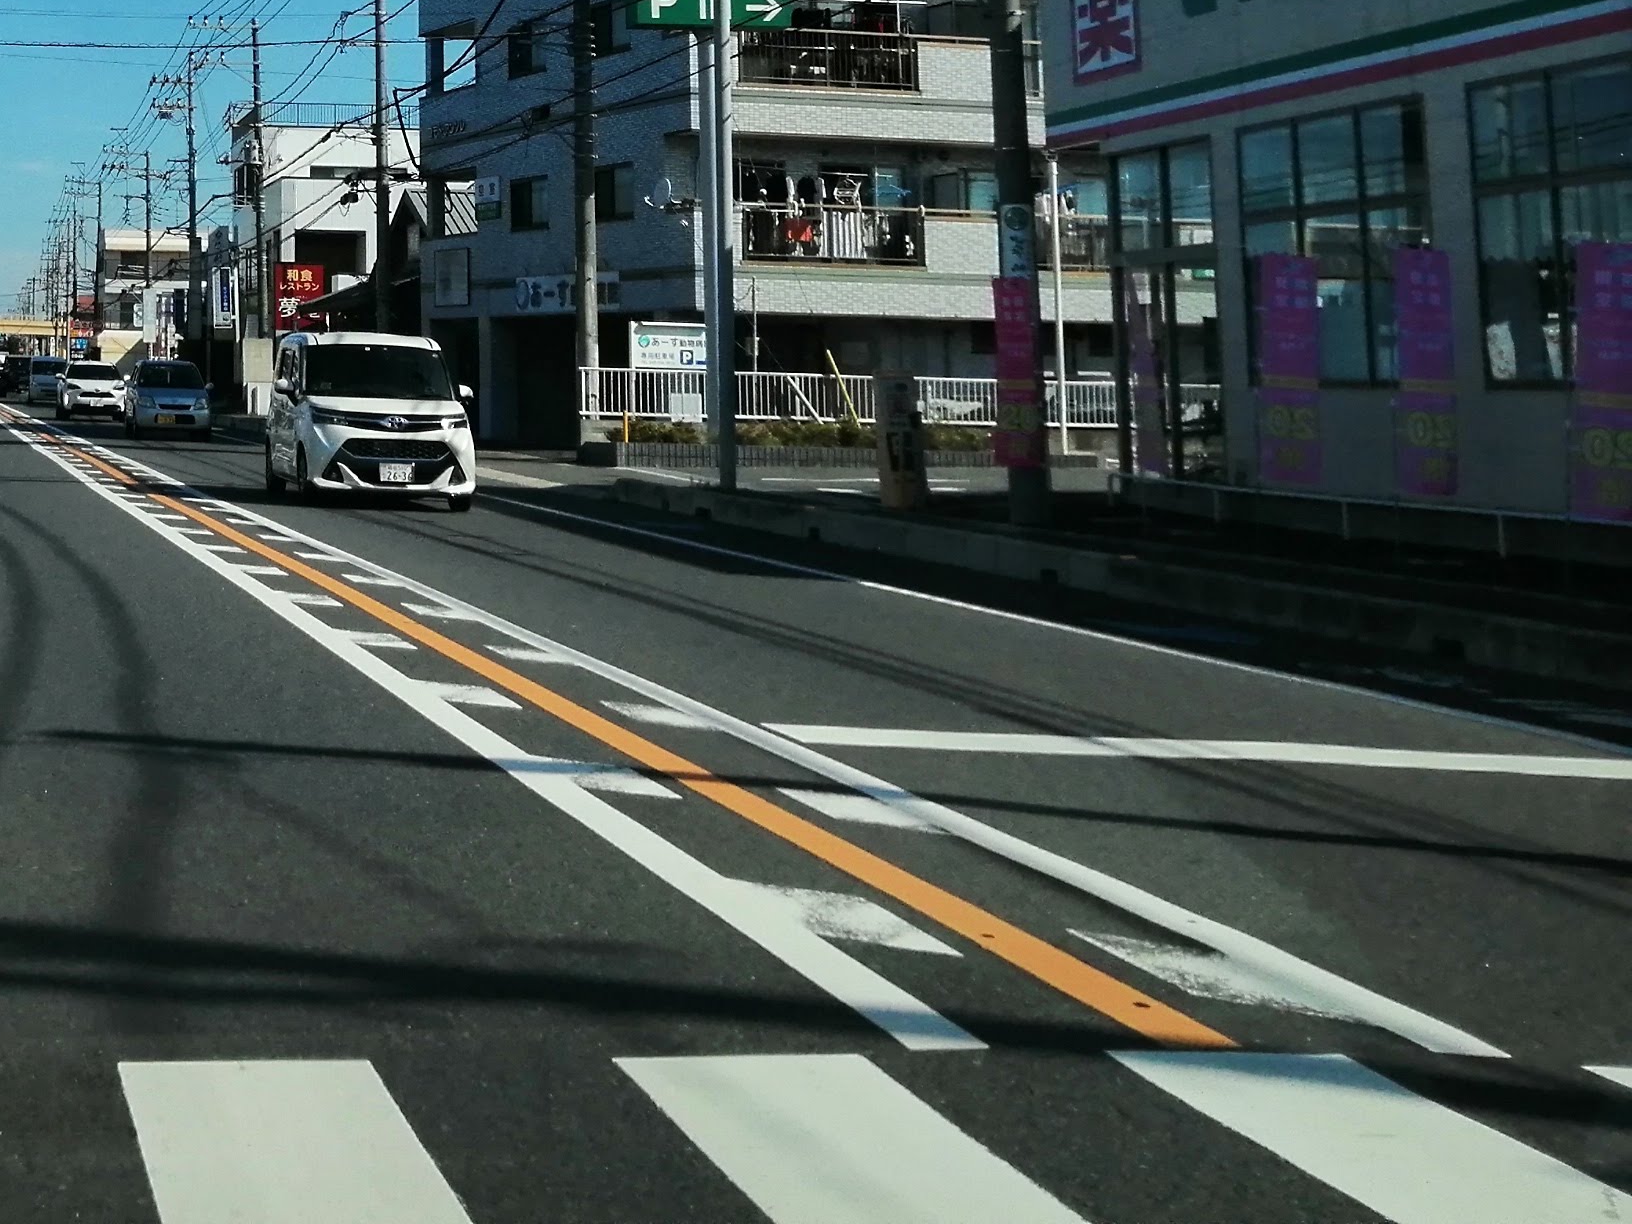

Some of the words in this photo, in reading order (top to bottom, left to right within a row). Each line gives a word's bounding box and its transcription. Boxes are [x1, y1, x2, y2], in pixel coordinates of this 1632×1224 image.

[286, 269, 313, 282] 和食
[279, 282, 320, 291] レストラン
